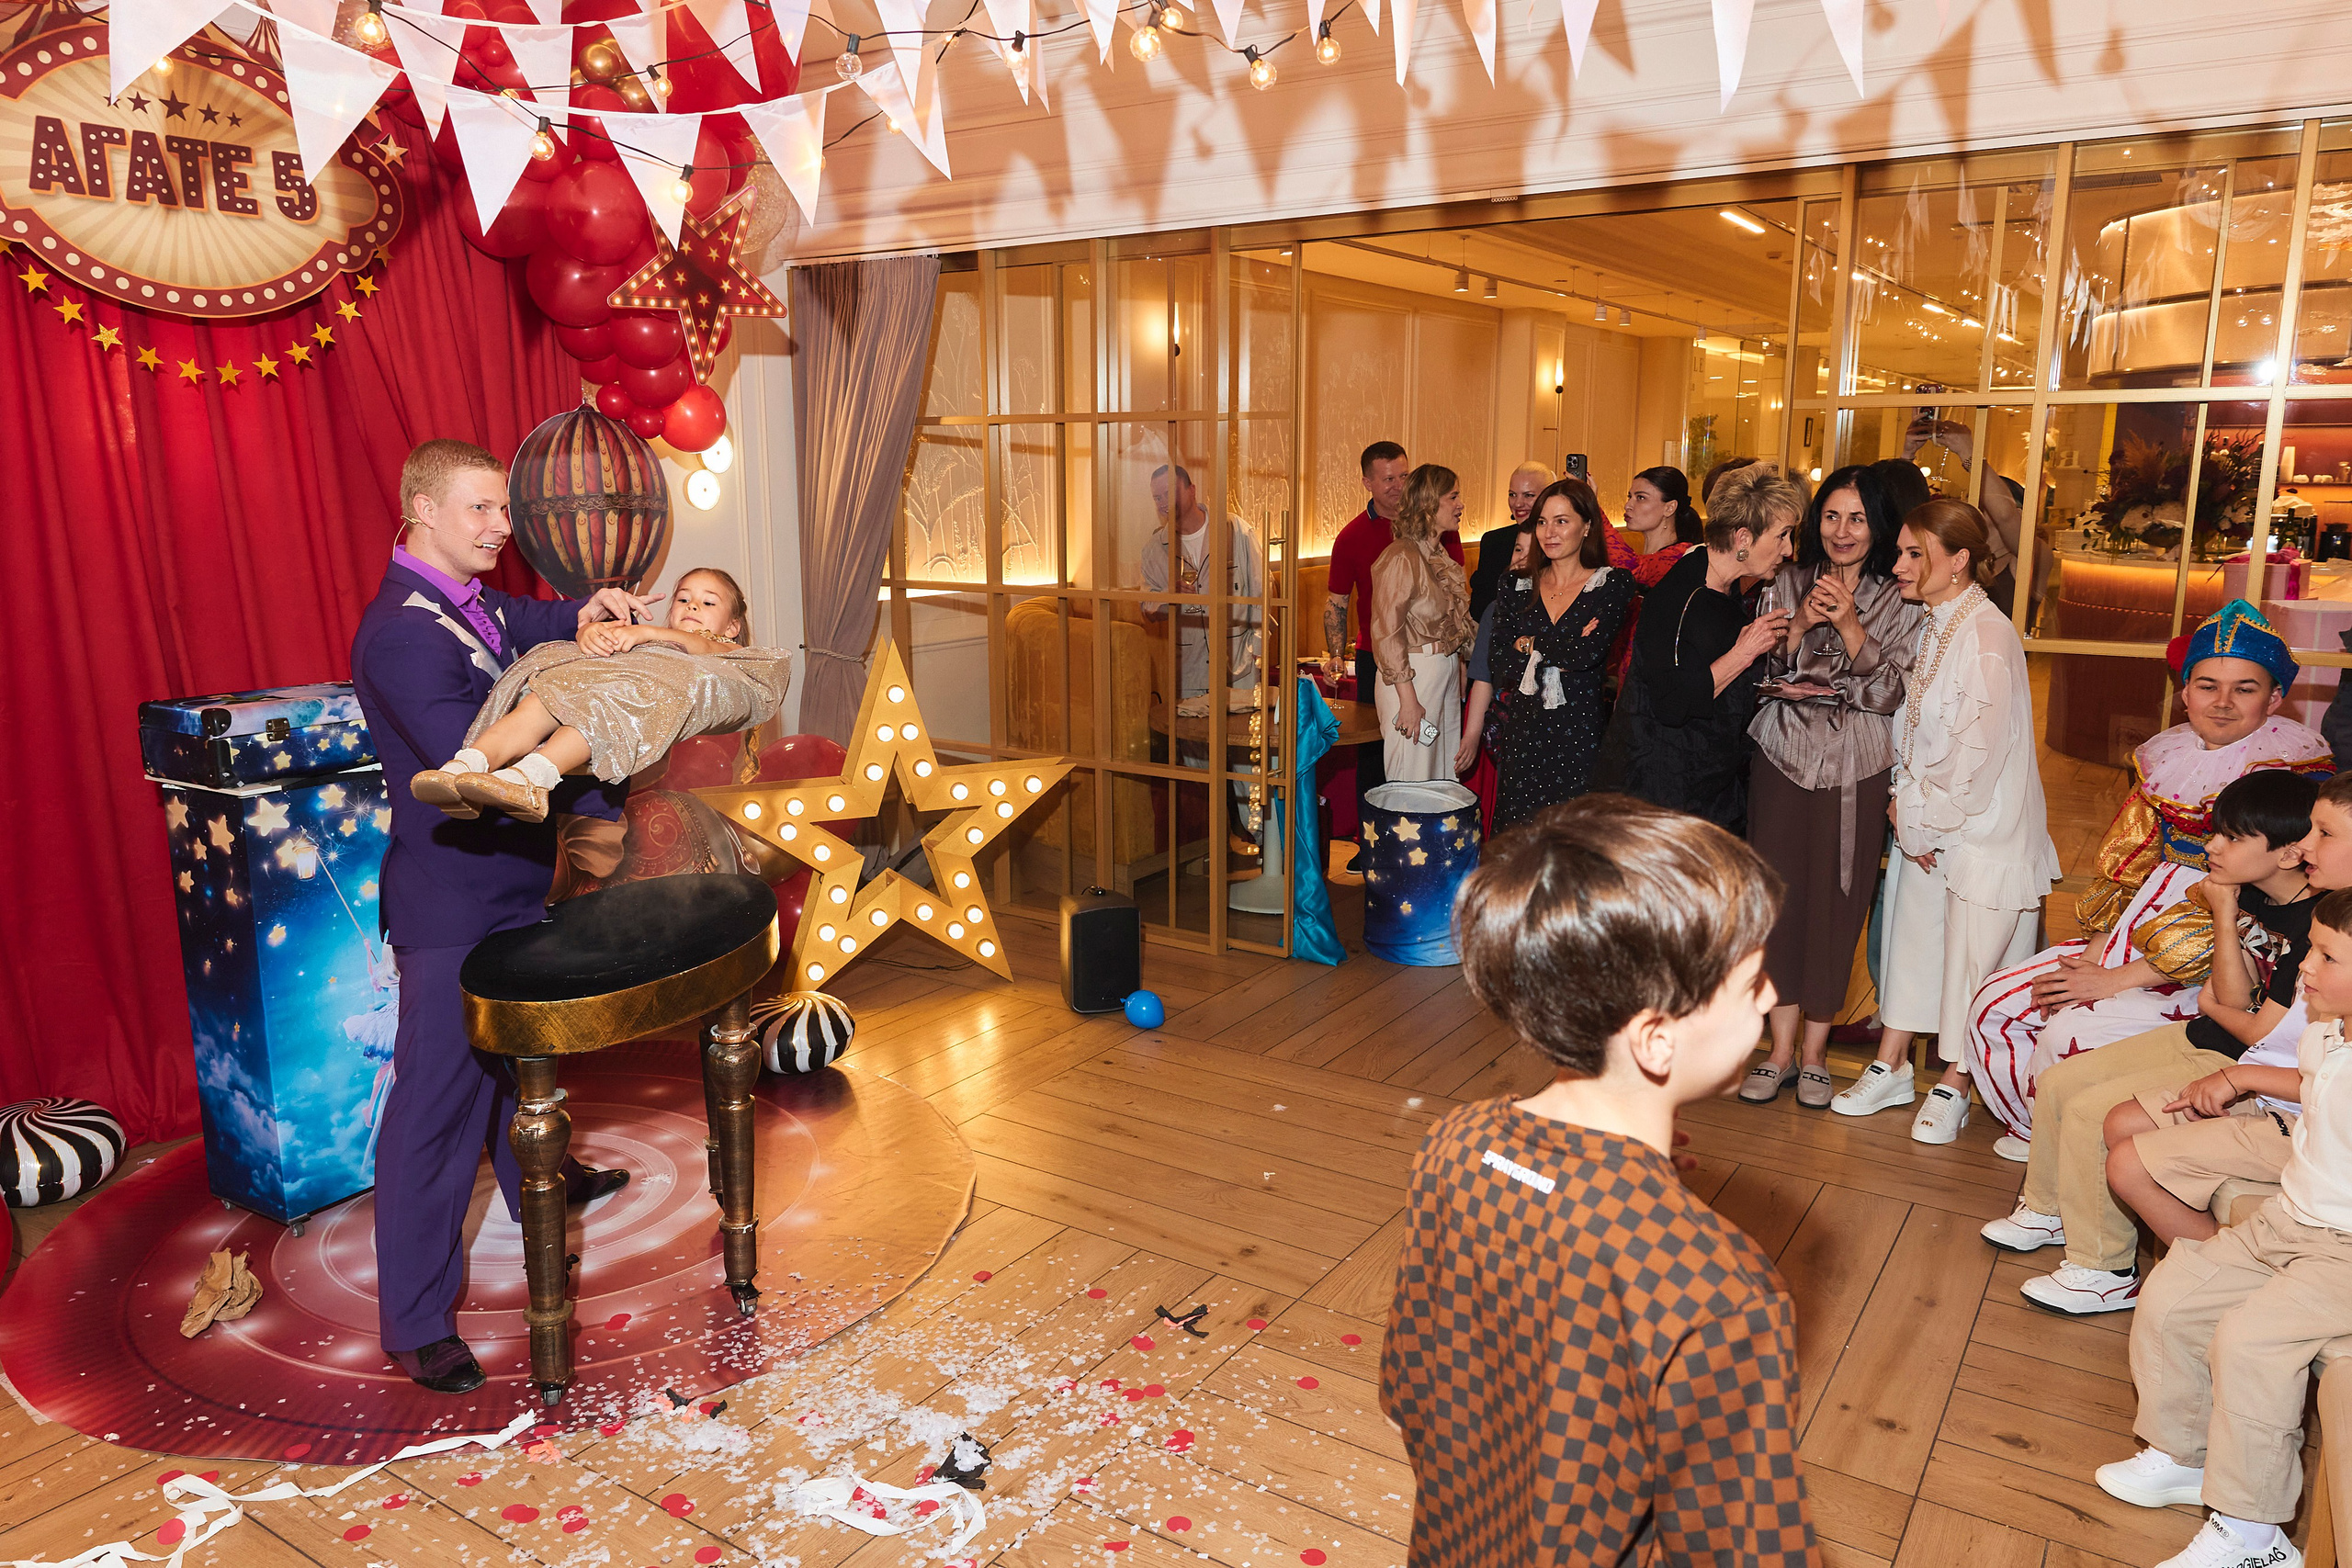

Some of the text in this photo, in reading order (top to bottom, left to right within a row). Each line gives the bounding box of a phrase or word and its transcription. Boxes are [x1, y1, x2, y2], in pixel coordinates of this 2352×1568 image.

[29, 116, 321, 222] АГАТЕ 5
[2222, 1547, 2287, 1568] GIELA6
